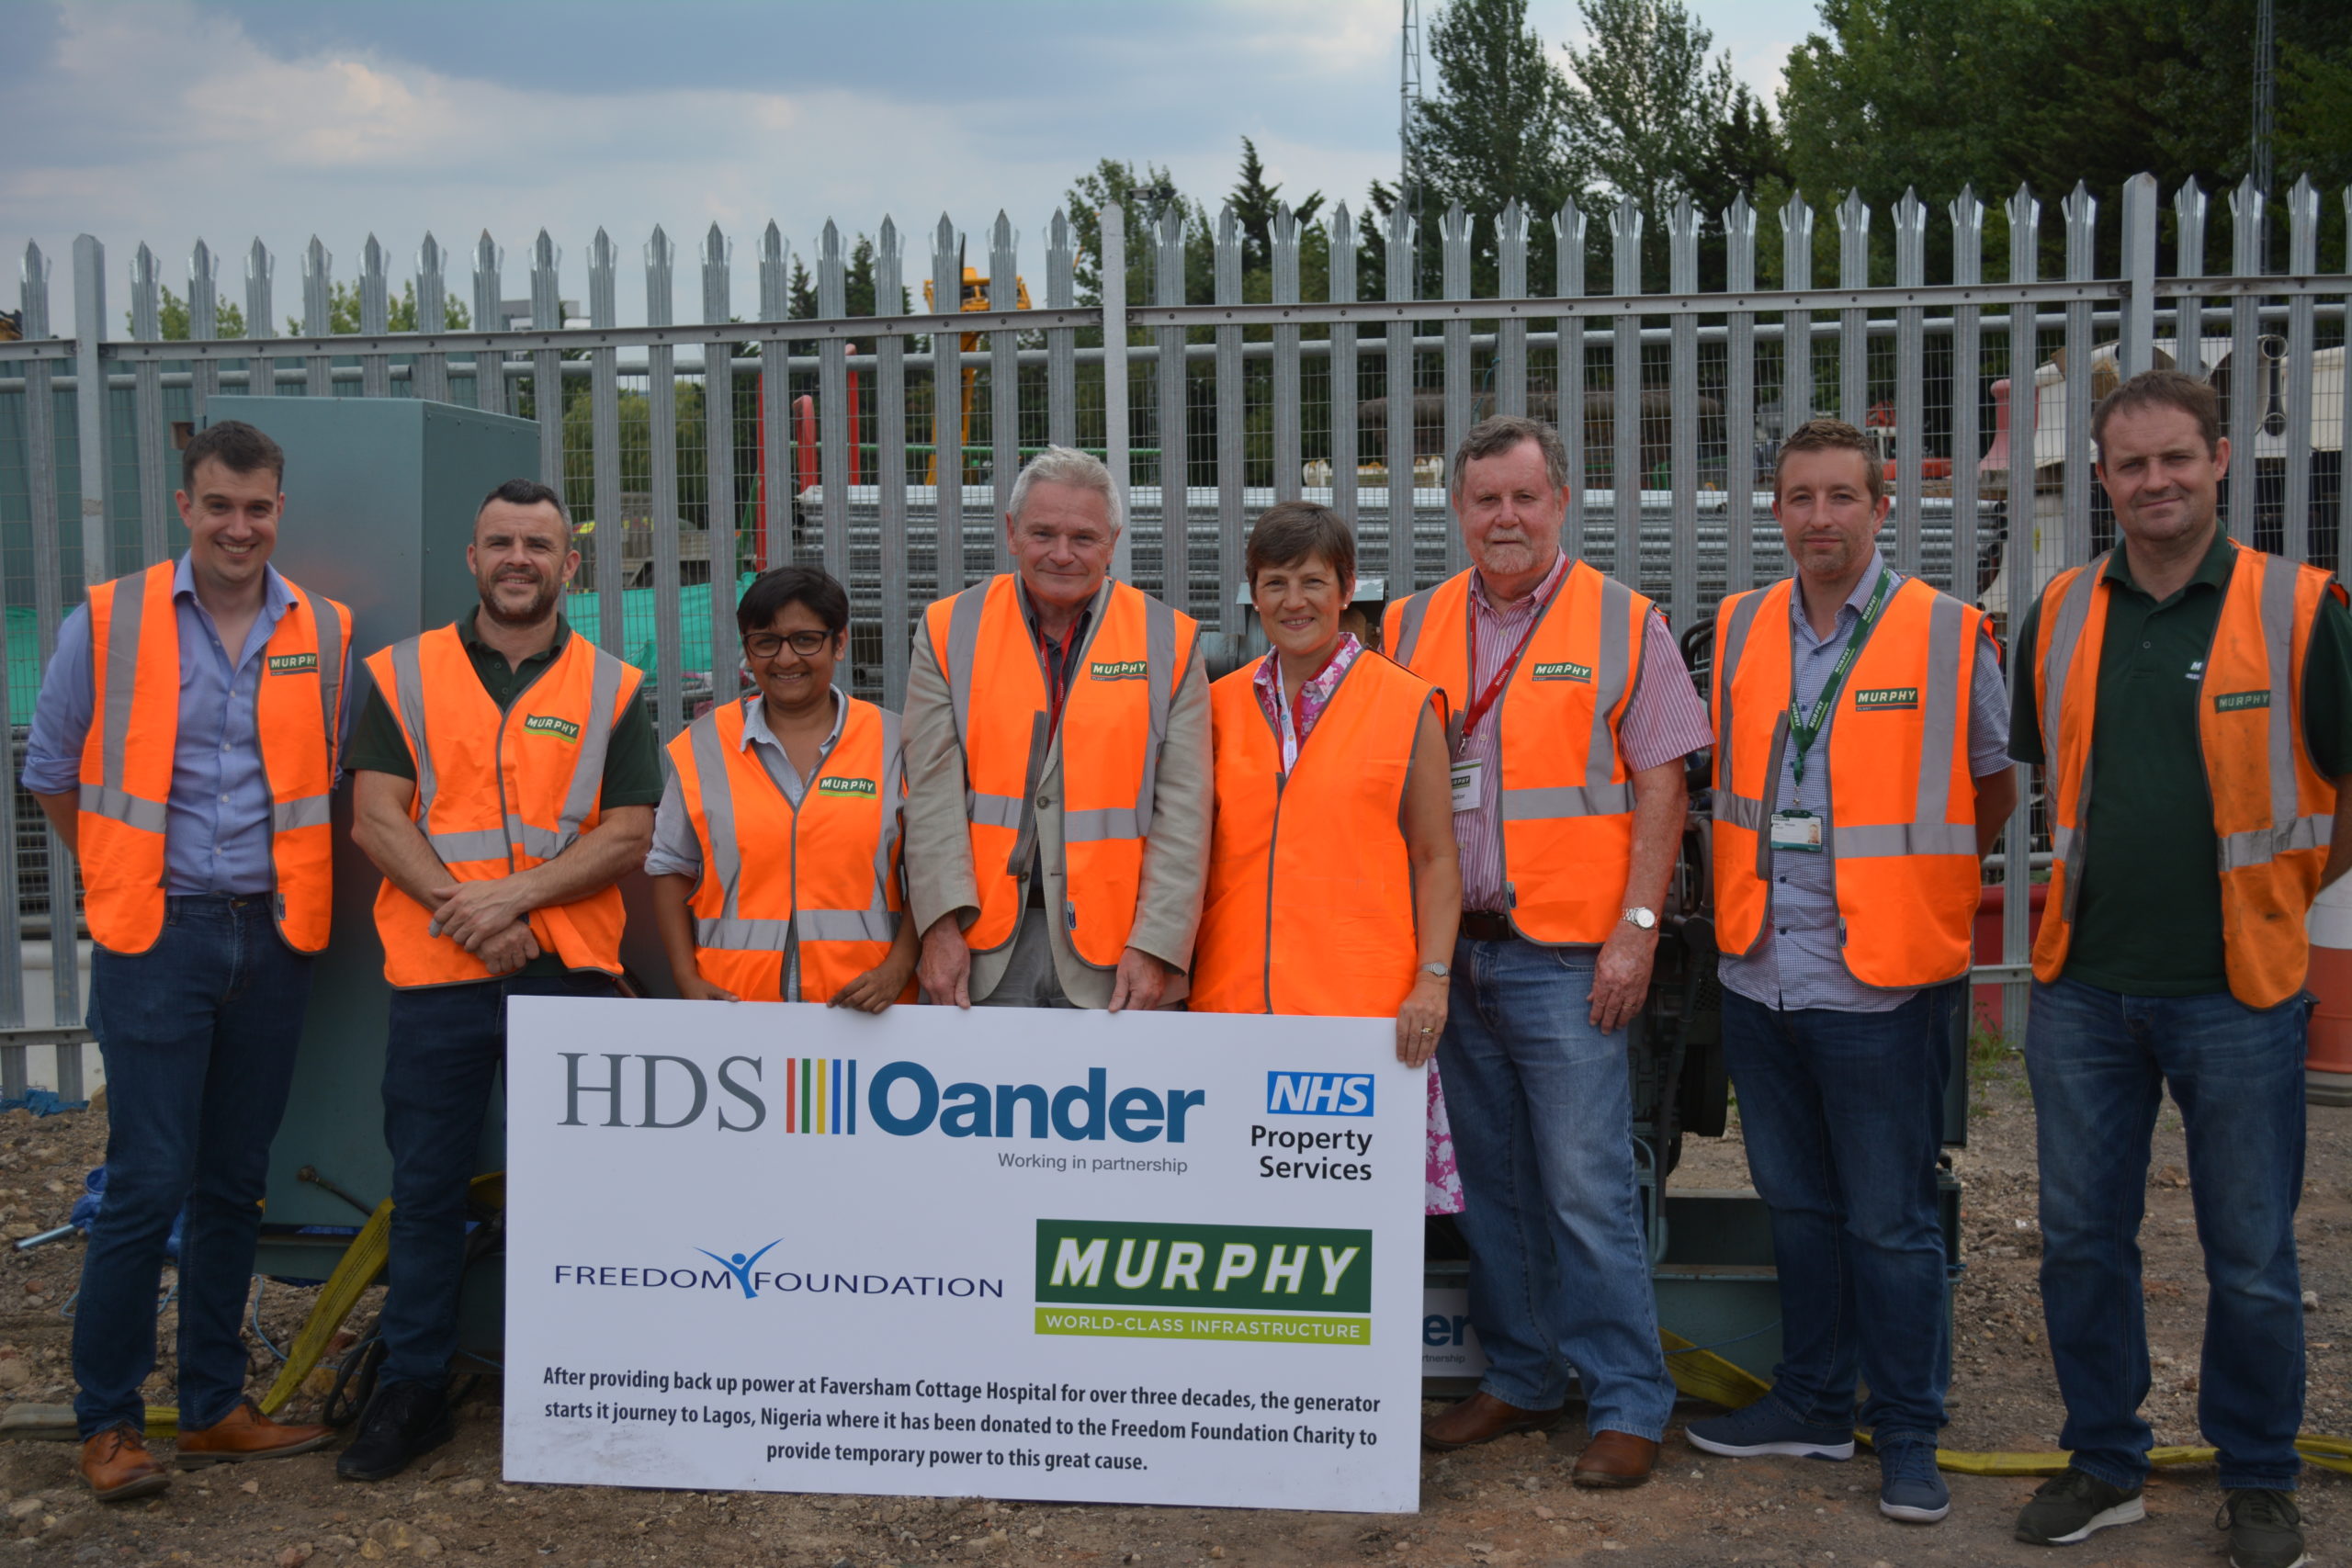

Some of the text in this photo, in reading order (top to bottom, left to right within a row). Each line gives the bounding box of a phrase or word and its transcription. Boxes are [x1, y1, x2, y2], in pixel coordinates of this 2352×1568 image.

[1861, 594, 1877, 621] MURPHY
[271, 655, 316, 669] MURPHY
[1092, 662, 1147, 675] MURPHY
[1535, 663, 1589, 676] MURPHY
[1835, 648, 1850, 673] MURPHY
[1858, 691, 1917, 703] MURPHY
[2219, 694, 2269, 708] MURPHY
[526, 717, 578, 735] MURPHY
[1809, 701, 1824, 728] MURPHY
[821, 778, 874, 792] MURPHY
[557, 1053, 1205, 1143] HDS Oander
[1270, 1075, 1371, 1113] NHS
[1251, 1125, 1373, 1156] Property
[999, 1152, 1188, 1176] Working in partnership
[1260, 1156, 1372, 1181] Services
[1049, 1237, 1360, 1295] MURPHY
[555, 1265, 1003, 1297] FREEDOM FOUNDATION
[1046, 1314, 1360, 1337] WORLD-CLASS INFRASTRUCTURE
[1422, 1354, 1465, 1364] rtnership
[544, 1367, 1380, 1415] After providing back up power at Faversham Cottage Hospital for over three decades, the generator
[545, 1401, 1377, 1449] starts it journey to Lagos, Nigeria where it has been donated to the Freedom Foundation Charity to
[767, 1442, 1148, 1472] provide temporary power to this great cause.
